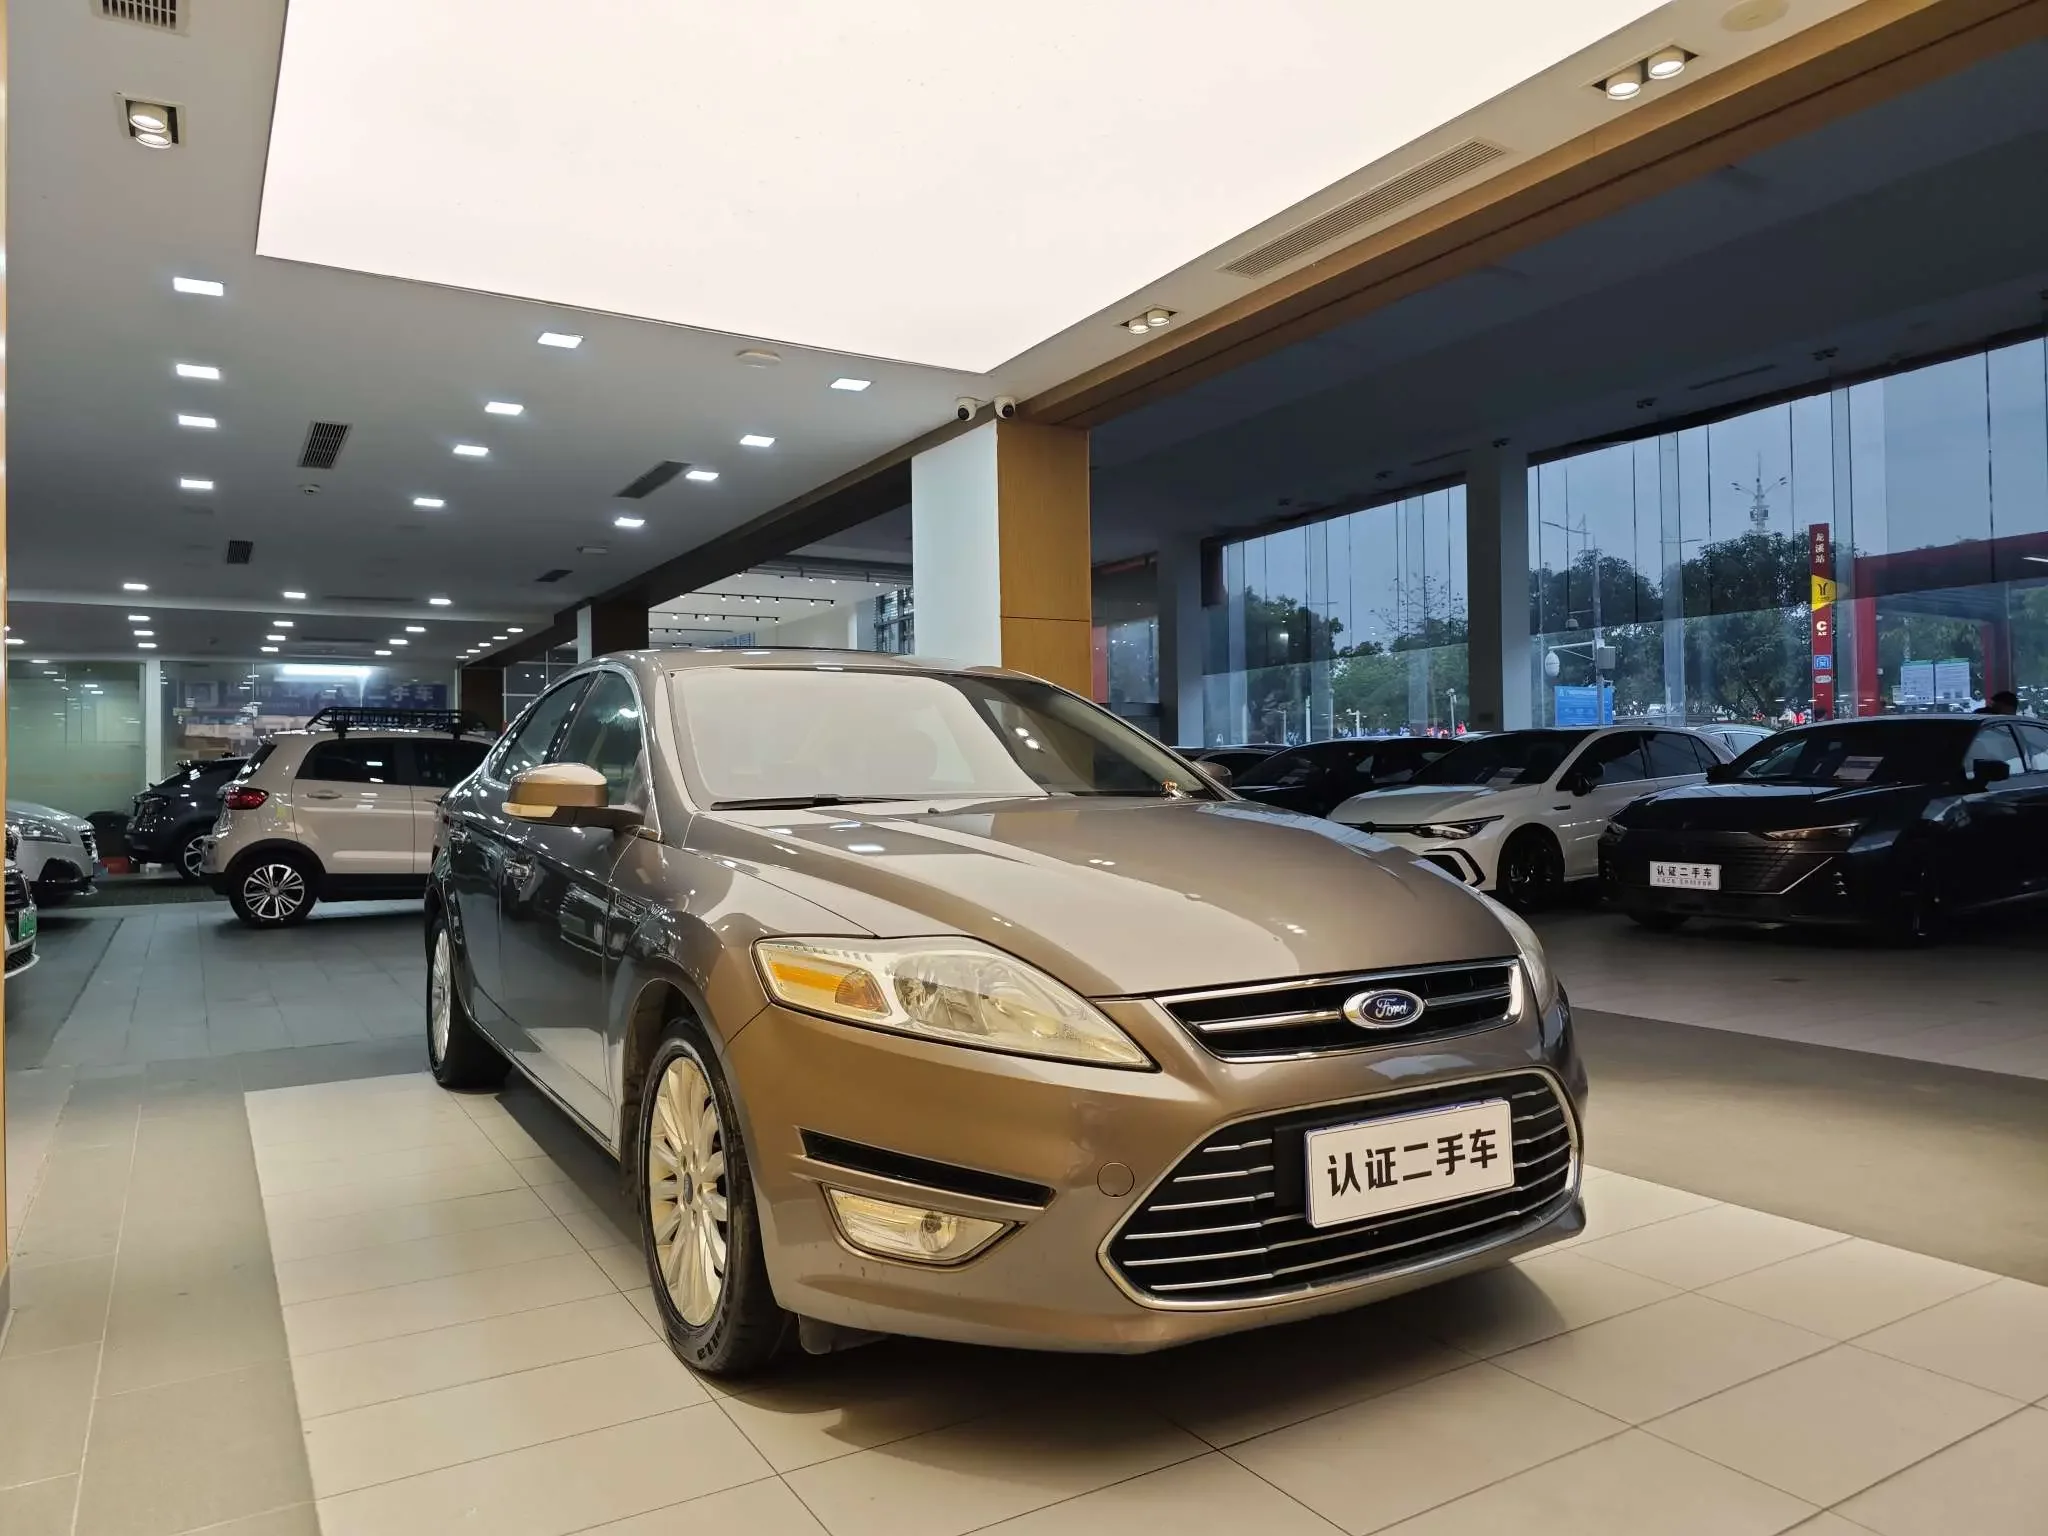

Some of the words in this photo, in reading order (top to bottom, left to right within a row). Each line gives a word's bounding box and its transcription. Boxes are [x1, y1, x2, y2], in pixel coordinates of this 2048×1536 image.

[1816, 620, 1827, 631] C
[1656, 865, 1712, 879] 认证二手车
[1375, 998, 1409, 1018] Ford
[1327, 1128, 1498, 1197] 认证二手车
